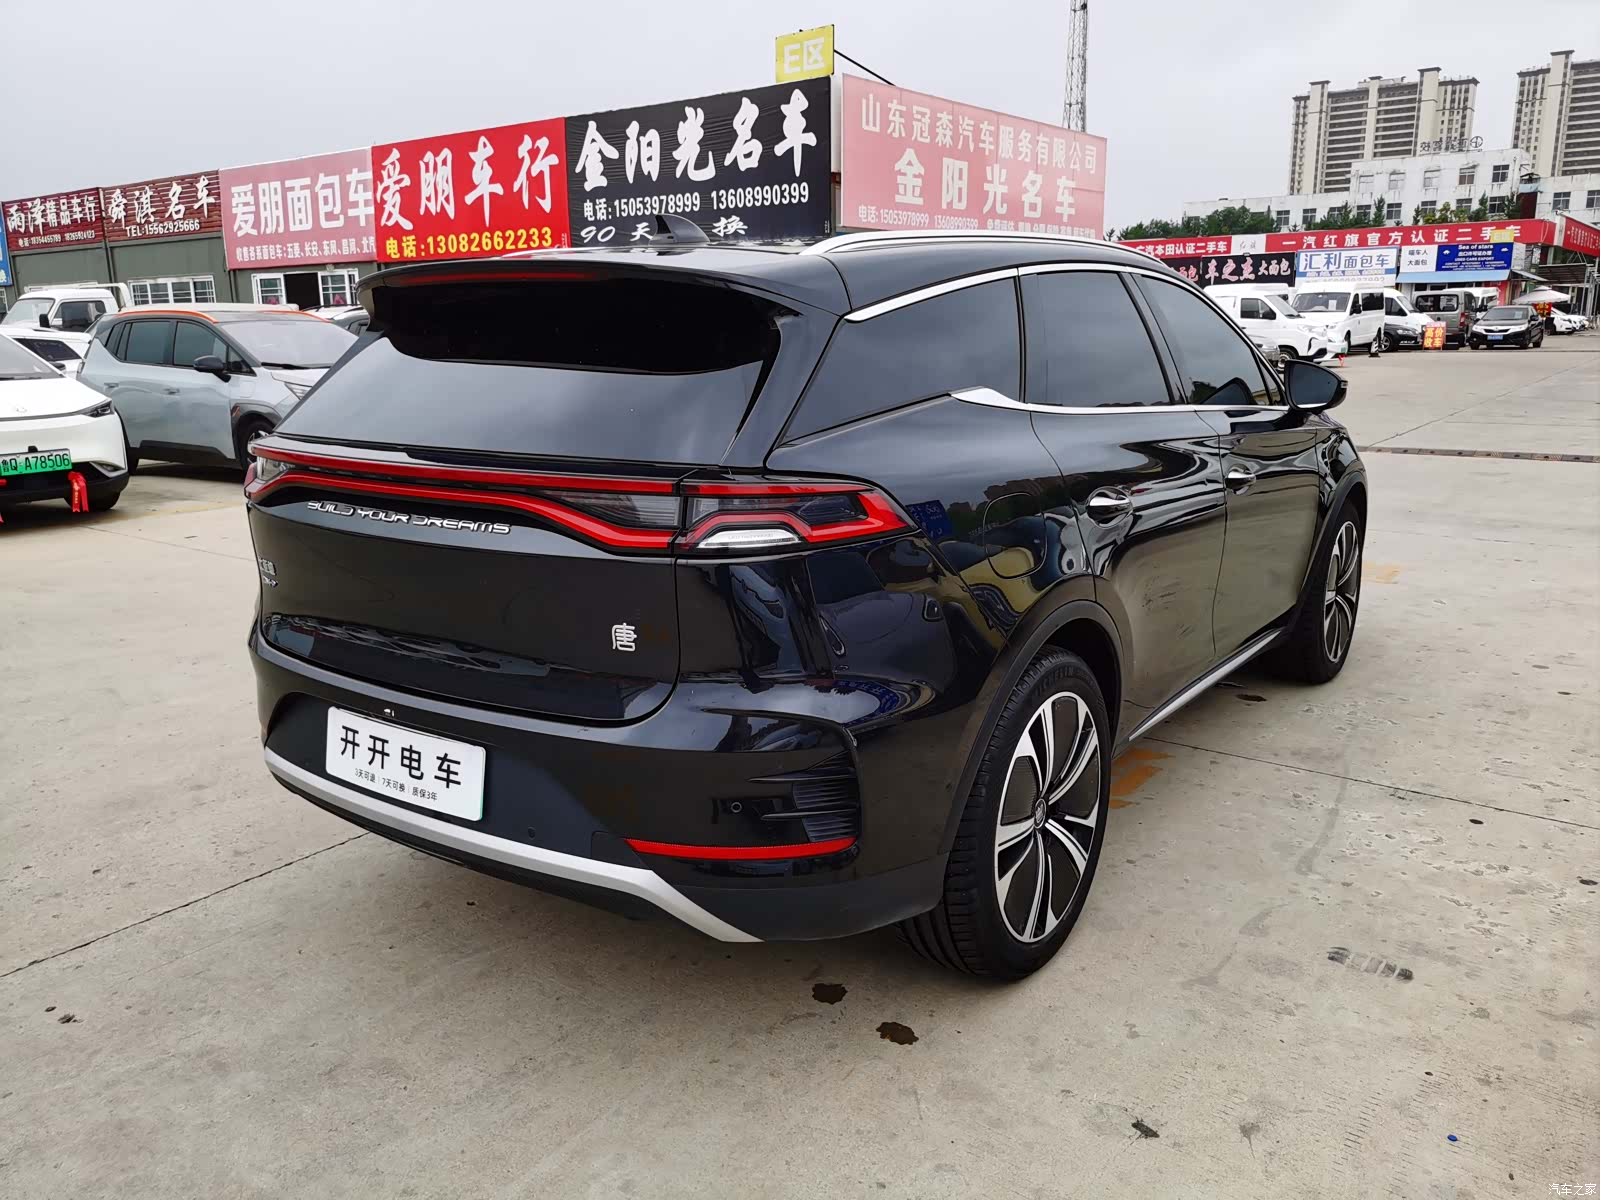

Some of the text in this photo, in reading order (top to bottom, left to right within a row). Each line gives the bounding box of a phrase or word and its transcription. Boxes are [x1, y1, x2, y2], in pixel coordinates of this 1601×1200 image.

[783, 36, 825, 74] E区
[575, 89, 817, 192] 金阳光名车
[862, 94, 1097, 174] 山东冠森汽车服务有限公司
[231, 168, 374, 237] 爱朋面包车
[376, 134, 560, 231] 爱朋车行
[711, 182, 809, 210] 13608990399
[894, 148, 1076, 222] 金阳光名车
[1303, 251, 1392, 271] 汇利面包车
[24, 453, 70, 471] A78506
[308, 500, 511, 535] BUILD YOUR DREAMS
[340, 725, 461, 789] 开开电车
[411, 786, 438, 801] 质保3年
